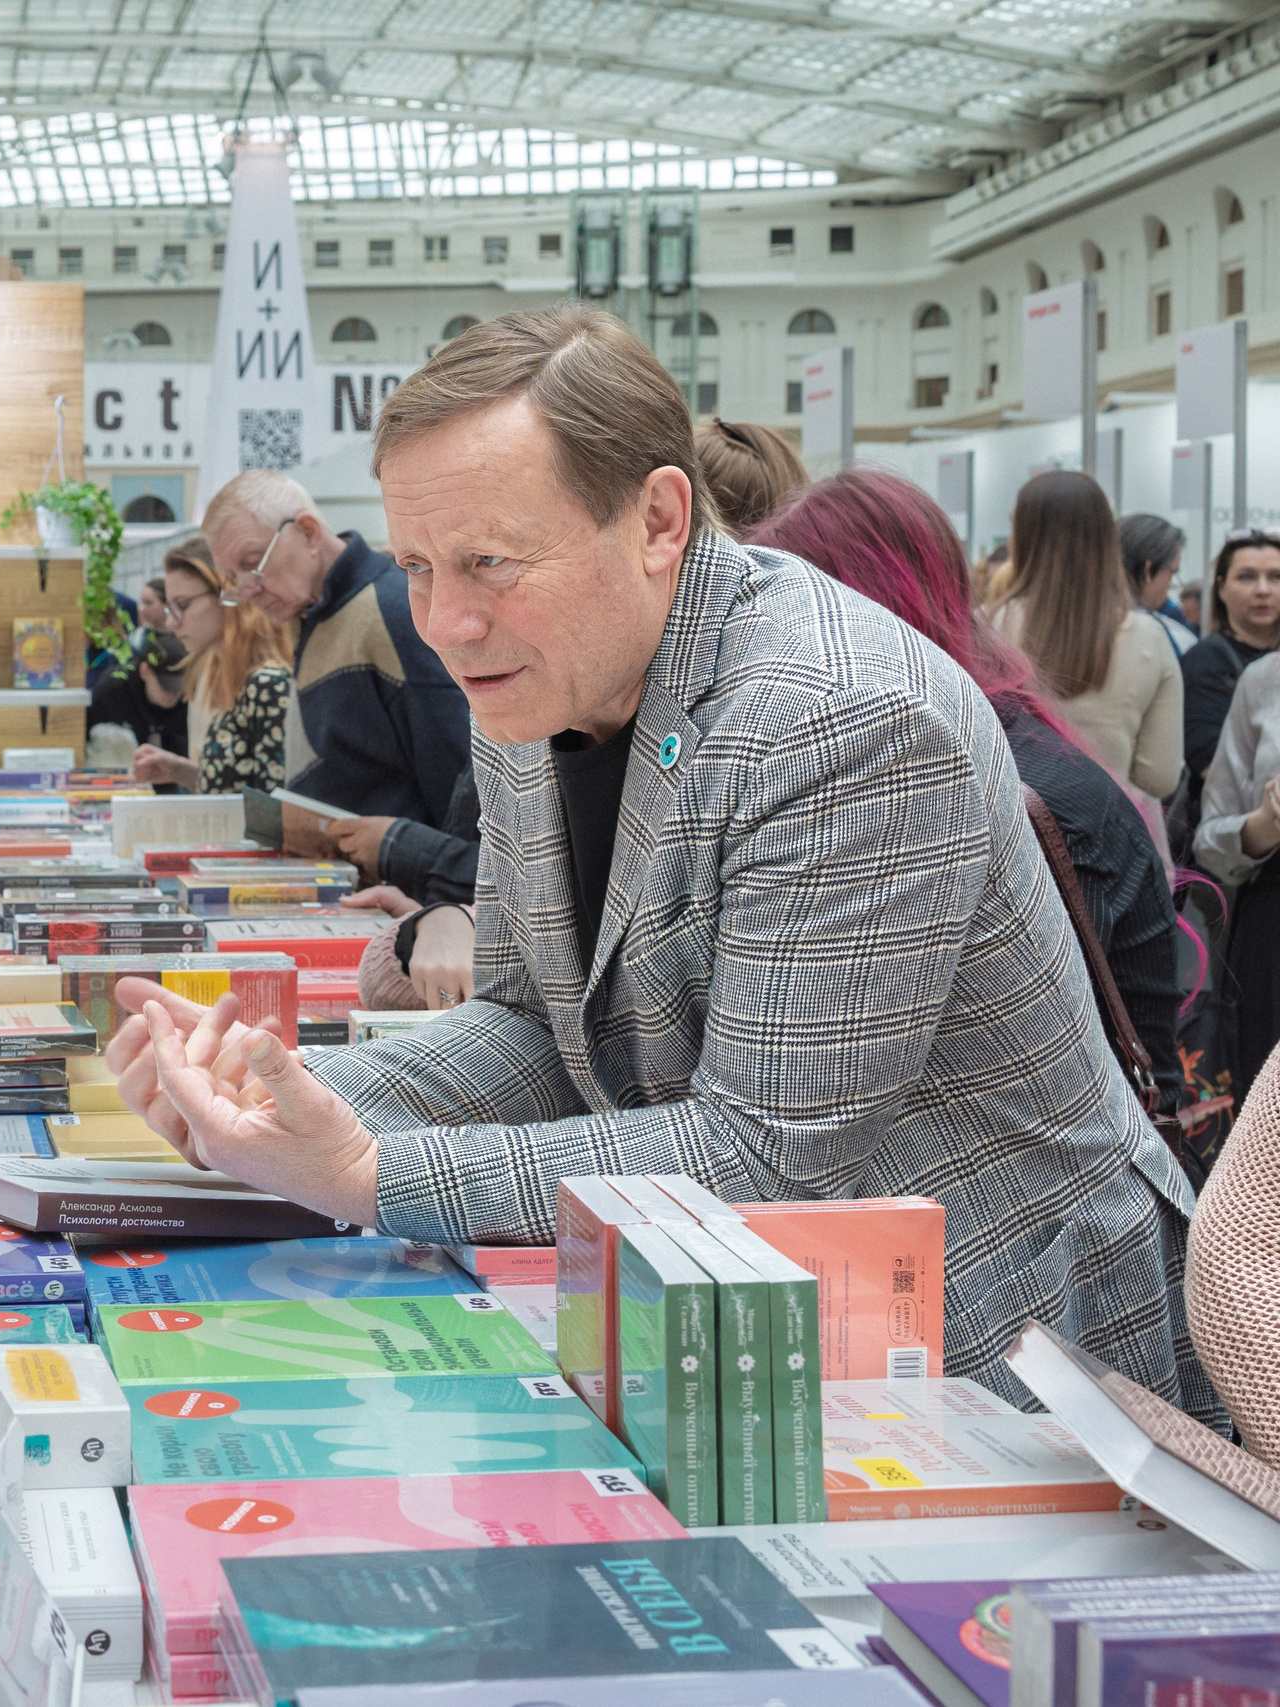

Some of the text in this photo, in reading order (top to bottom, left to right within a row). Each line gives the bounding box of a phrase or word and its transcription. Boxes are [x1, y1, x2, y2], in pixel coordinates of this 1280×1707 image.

[59, 1214, 185, 1228] Психология достоинства
[60, 1200, 163, 1214] Александр Асмолов
[48, 1256, 74, 1271] 450
[367, 1328, 410, 1372] Останови
[400, 1301, 466, 1372] эмоциональные
[453, 1337, 493, 1370] качели
[684, 1381, 705, 1471] Выученный
[741, 1380, 759, 1467] Выученный
[790, 1379, 810, 1467] Выученный
[154, 1424, 191, 1479] Не корми
[193, 1447, 222, 1477] свою
[217, 1432, 260, 1476] тревогу
[920, 1501, 1060, 1518] Ребенок-оптимист
[600, 1557, 704, 1630] СЕБЯ
